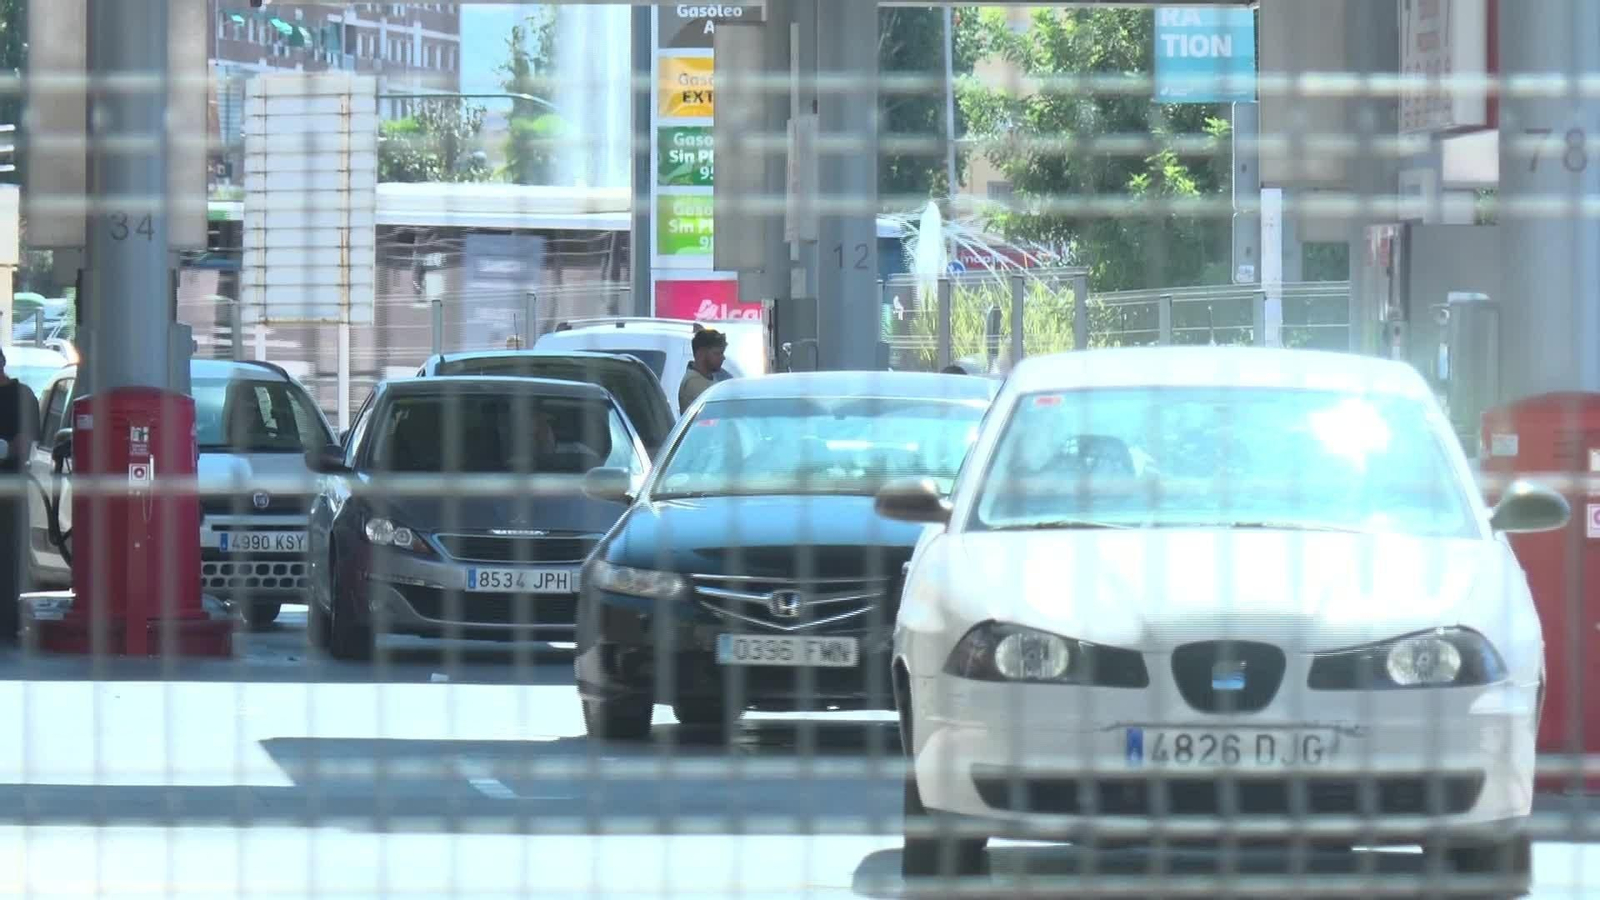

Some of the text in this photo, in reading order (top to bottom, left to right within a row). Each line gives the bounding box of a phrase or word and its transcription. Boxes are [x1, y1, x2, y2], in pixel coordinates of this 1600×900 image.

[703, 20, 715, 34] A
[1159, 33, 1232, 58] TION
[668, 149, 695, 163] Sin
[110, 210, 155, 241] 34
[699, 235, 714, 251] 9
[833, 243, 870, 269] 12
[231, 534, 305, 551] 4990 KSY
[479, 571, 568, 590] 8534 JPH
[1150, 732, 1324, 766] 4826 DJG
